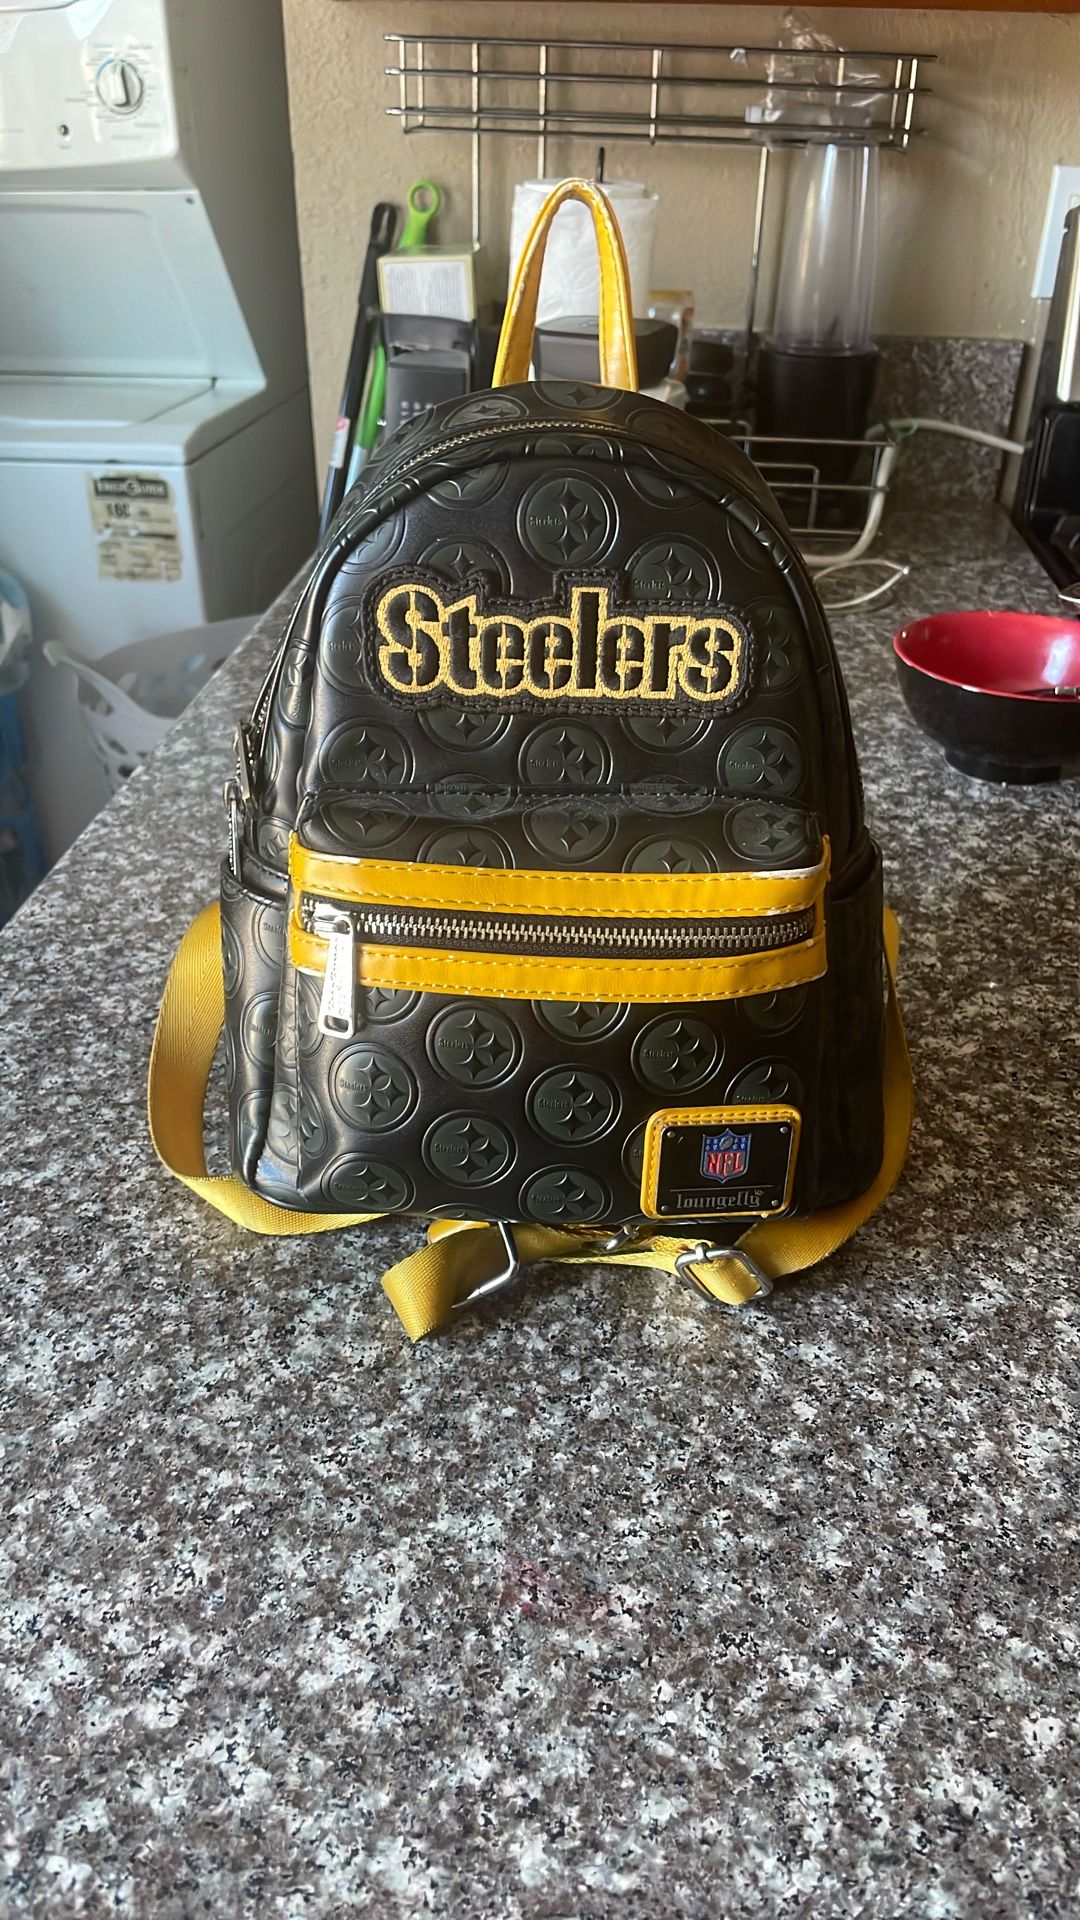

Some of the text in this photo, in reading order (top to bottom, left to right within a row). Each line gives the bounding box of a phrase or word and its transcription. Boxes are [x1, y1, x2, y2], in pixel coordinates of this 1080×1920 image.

[376, 584, 743, 701] Steelers
[438, 1037, 471, 1050] Steelers
[434, 1142, 466, 1155] Steelers
[706, 1151, 745, 1176] NFL
